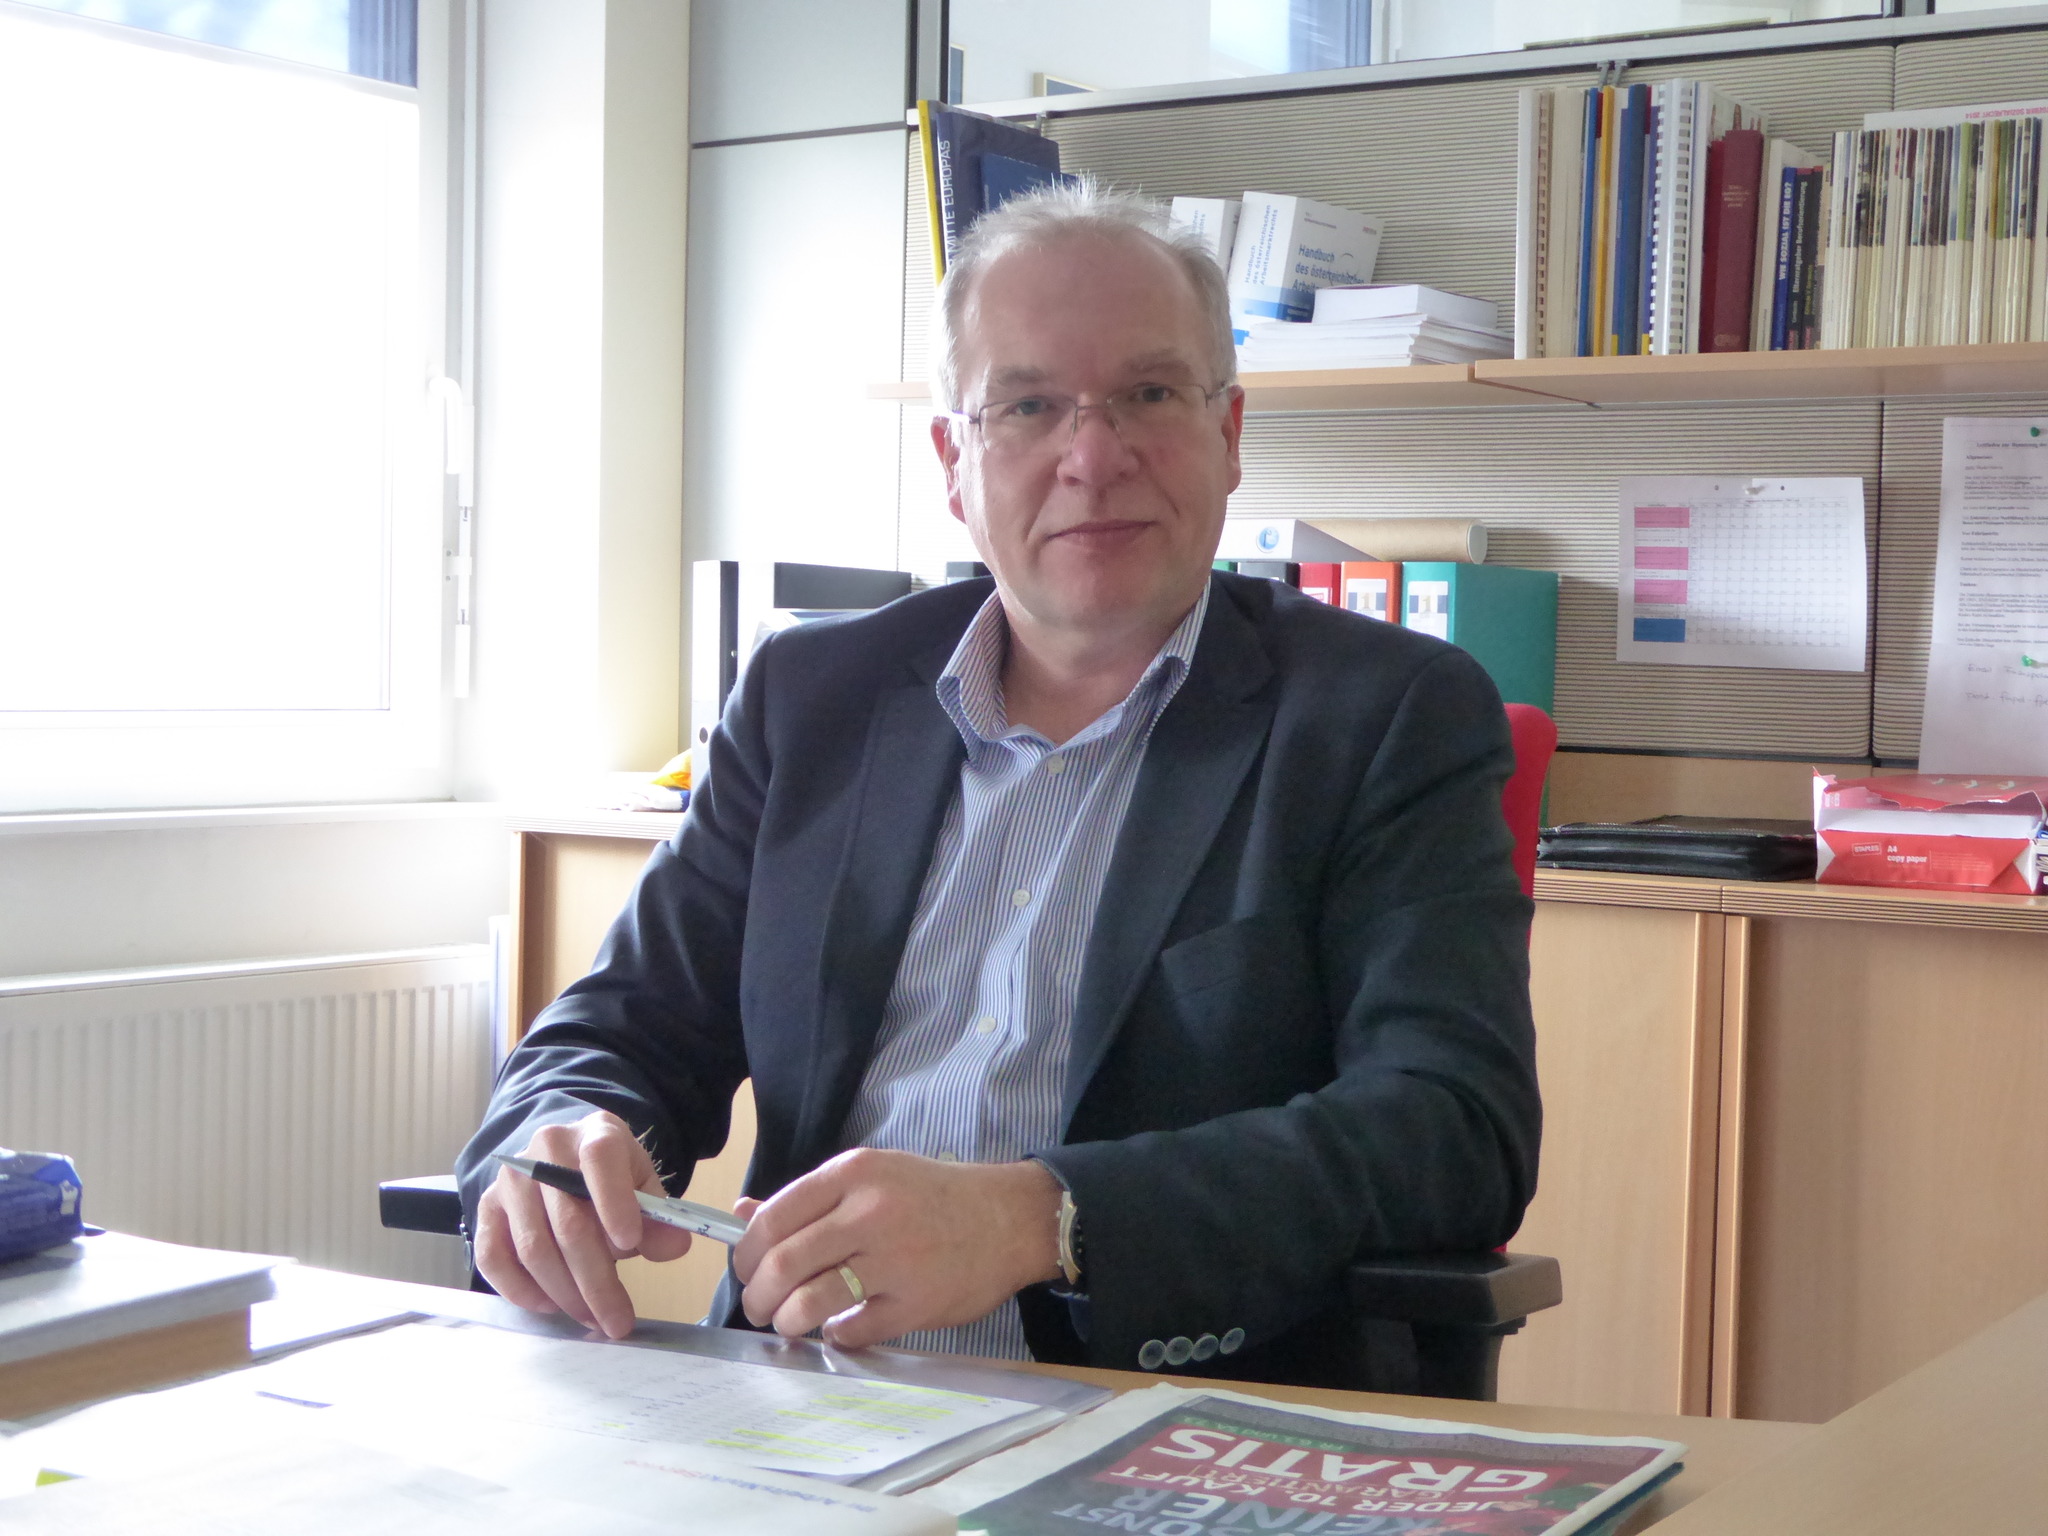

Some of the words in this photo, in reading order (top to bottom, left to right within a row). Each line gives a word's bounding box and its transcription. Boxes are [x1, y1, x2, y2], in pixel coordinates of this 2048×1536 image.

[940, 140, 954, 206] EUROPAS
[1783, 200, 1791, 213] DIE
[1782, 215, 1790, 230] IST
[1260, 209, 1278, 285] Arbeitsmarktrechts
[1298, 243, 1335, 263] Handbuch
[1780, 233, 1789, 262] SOZIAL
[1245, 244, 1256, 284] Handbuch
[1295, 262, 1309, 275] des
[1887, 845, 1897, 853] A4
[1887, 855, 1905, 863] copy
[1906, 855, 1928, 863] paper
[1151, 1429, 1548, 1492] GRATIS
[1110, 1466, 1266, 1495] KAUFT
[1285, 1490, 1338, 1506] 10.
[1353, 1500, 1498, 1513] JEDER
[1112, 1486, 1437, 1536] KEINER
